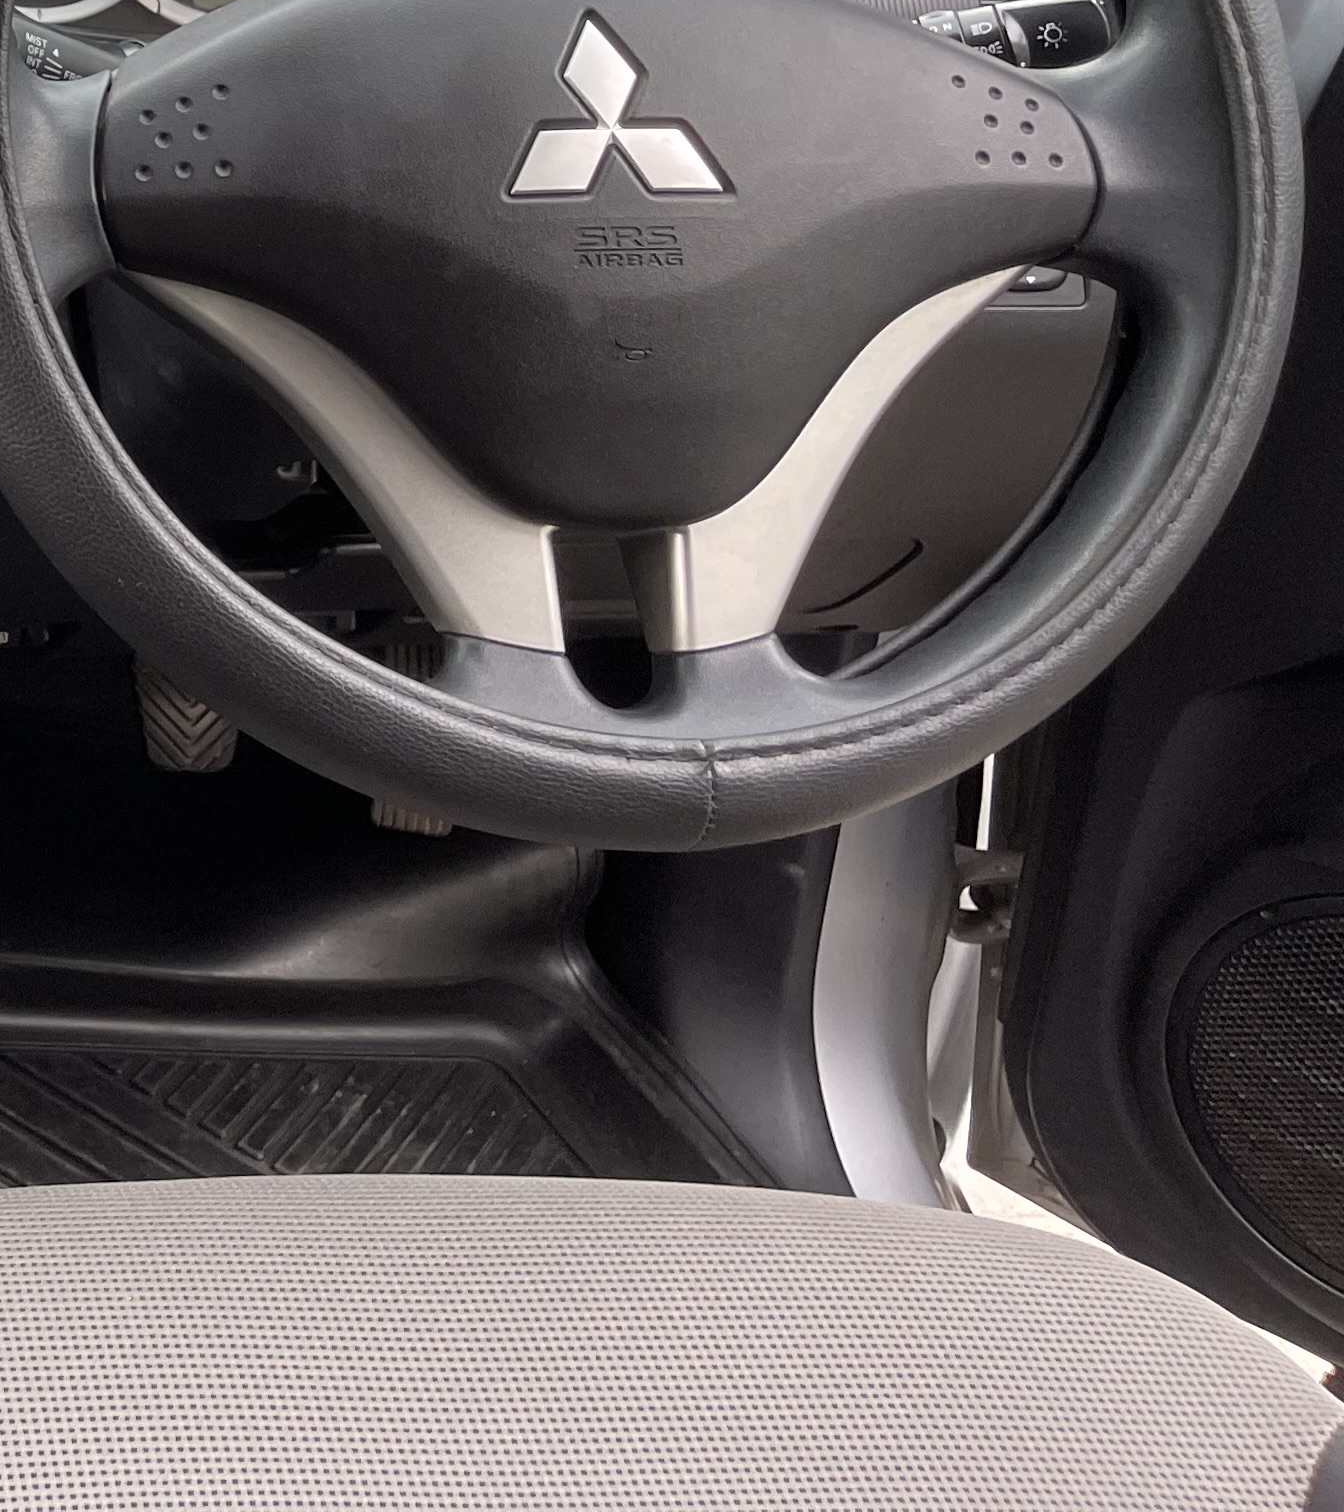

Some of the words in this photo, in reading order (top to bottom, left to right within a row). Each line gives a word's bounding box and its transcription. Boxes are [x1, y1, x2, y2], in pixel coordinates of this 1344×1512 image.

[25, 32, 48, 48] MIST
[27, 44, 45, 58] OFF
[26, 55, 42, 69] INT
[575, 226, 677, 247] SRS
[579, 252, 684, 267] AIRBAG
